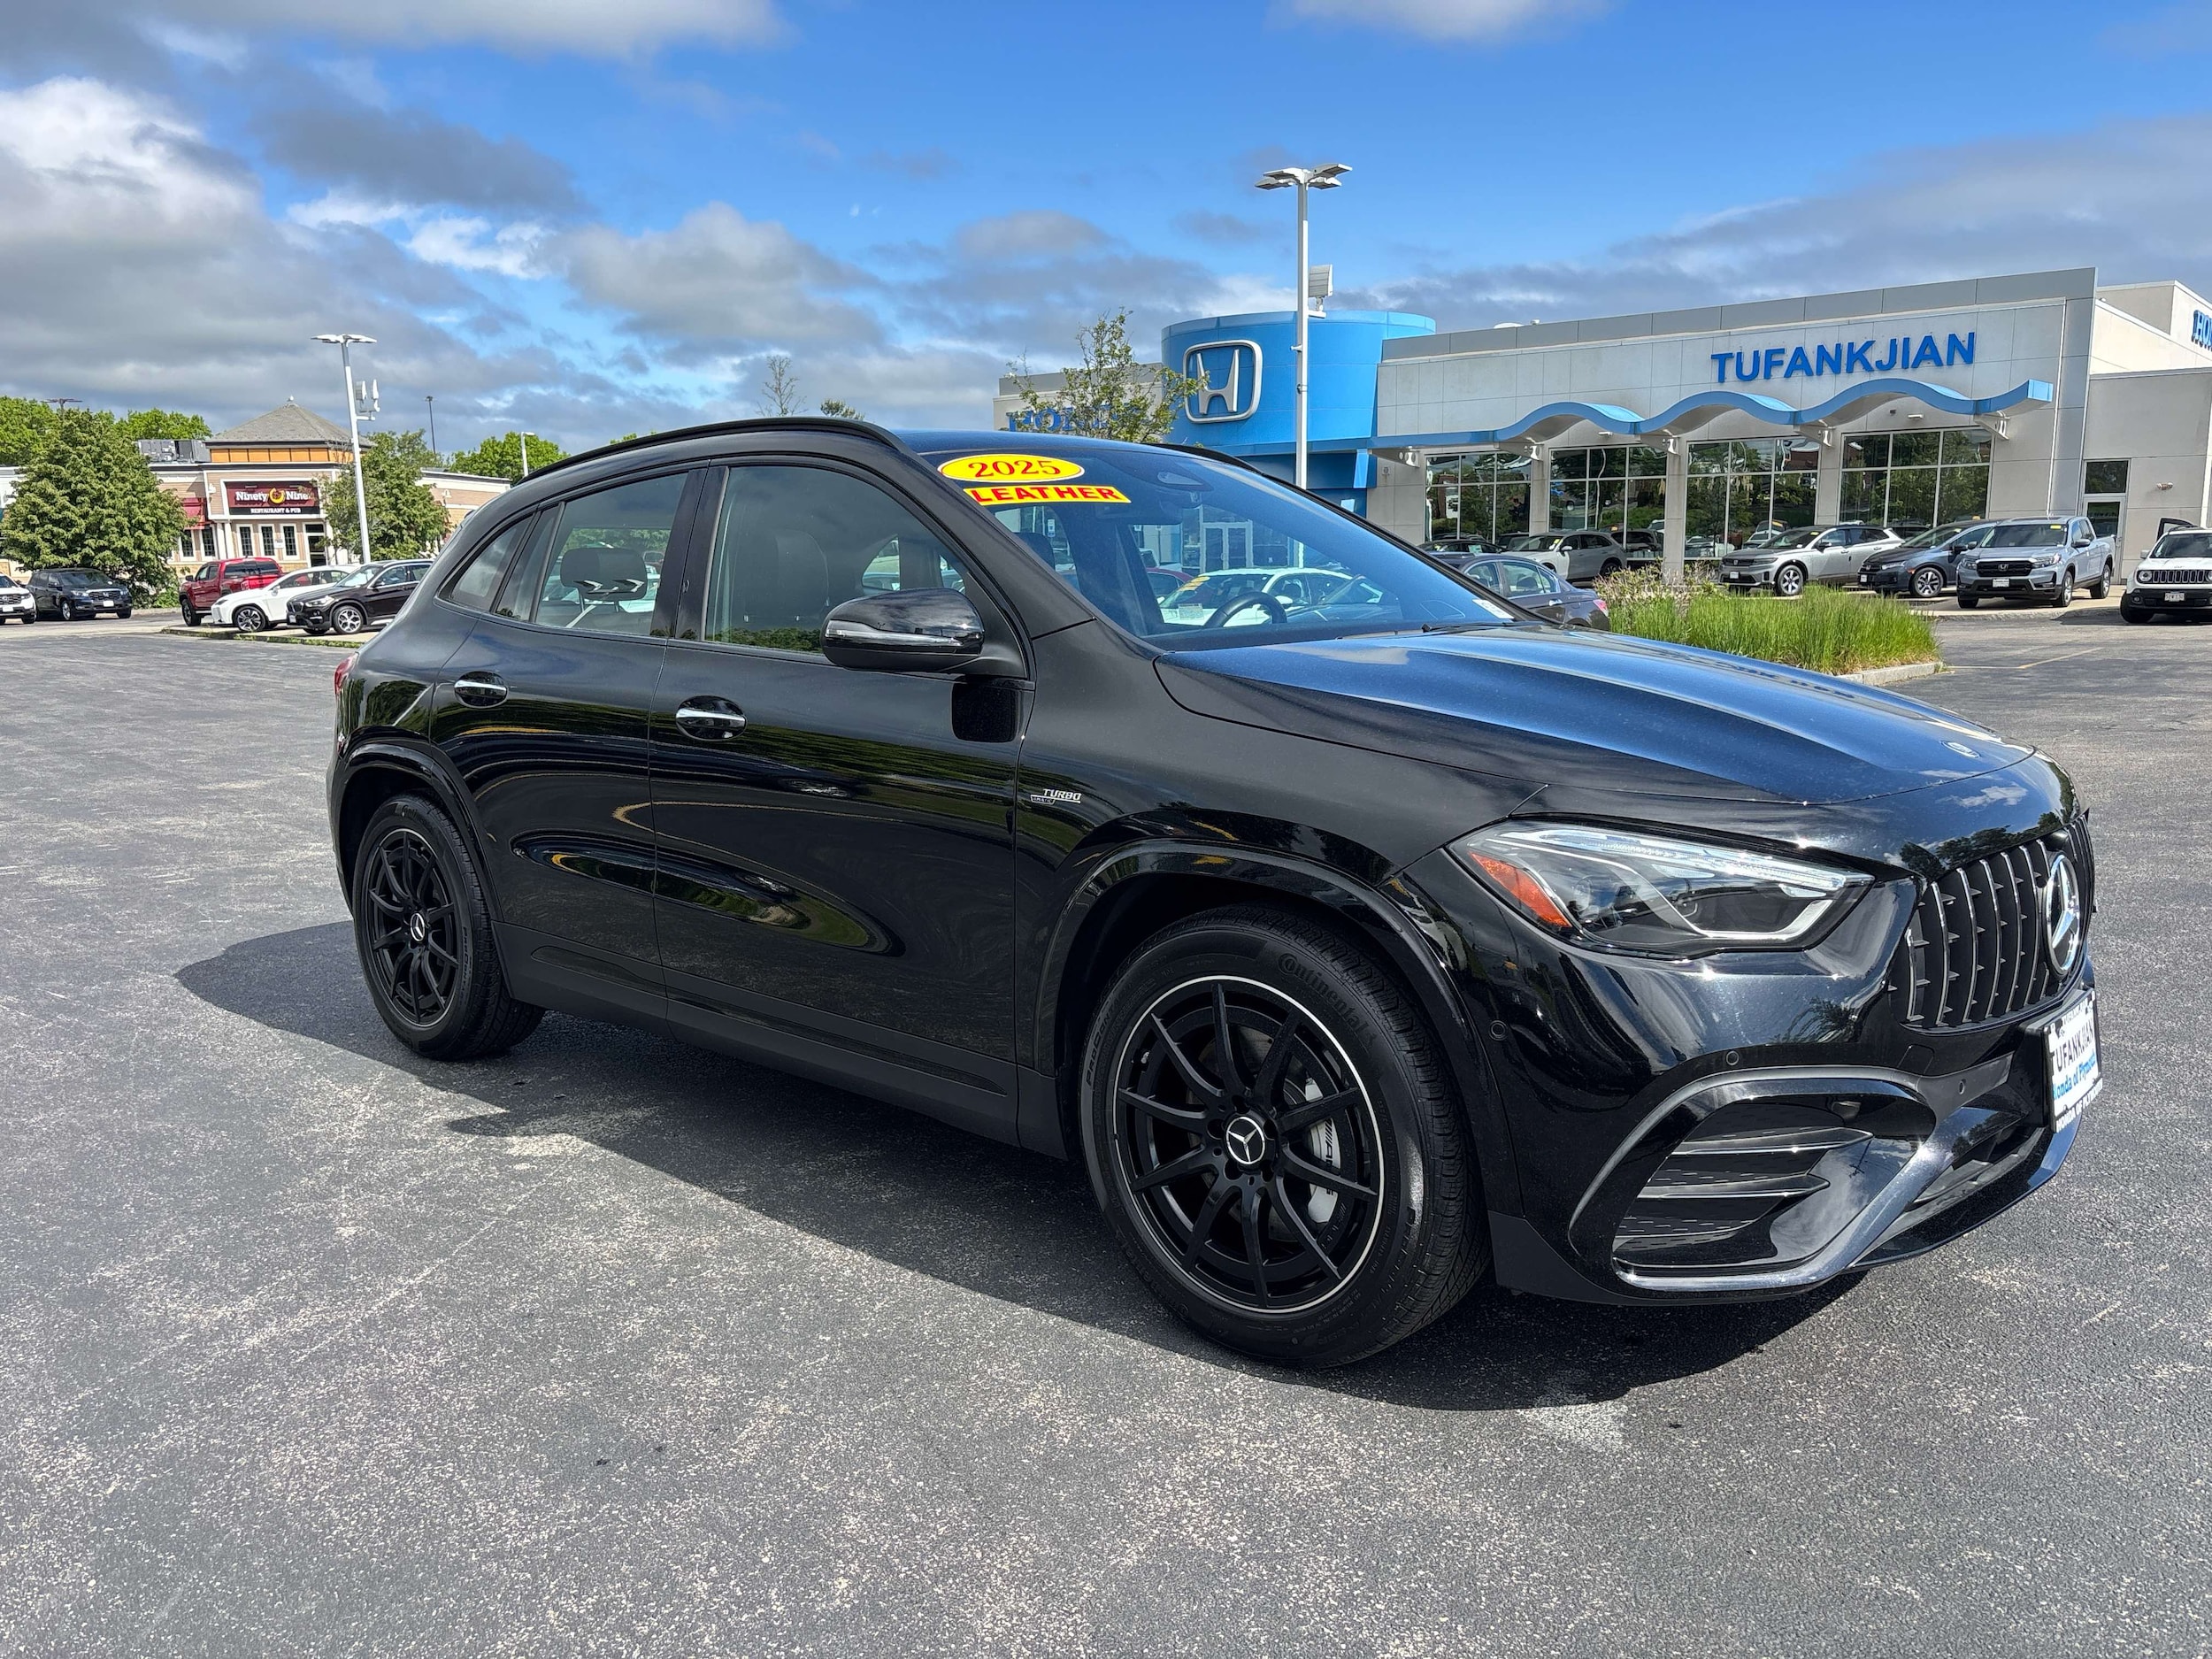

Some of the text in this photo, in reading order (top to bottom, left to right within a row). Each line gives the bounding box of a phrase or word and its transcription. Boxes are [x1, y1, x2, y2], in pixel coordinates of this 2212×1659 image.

[2193, 310, 2212, 347] HO
[1711, 332, 1975, 383] TUFANKJIAN
[968, 460, 1060, 478] 2025
[235, 491, 309, 502] Ninety Nine
[971, 487, 1121, 503] LEATHER
[1043, 788, 1081, 800] TURBO
